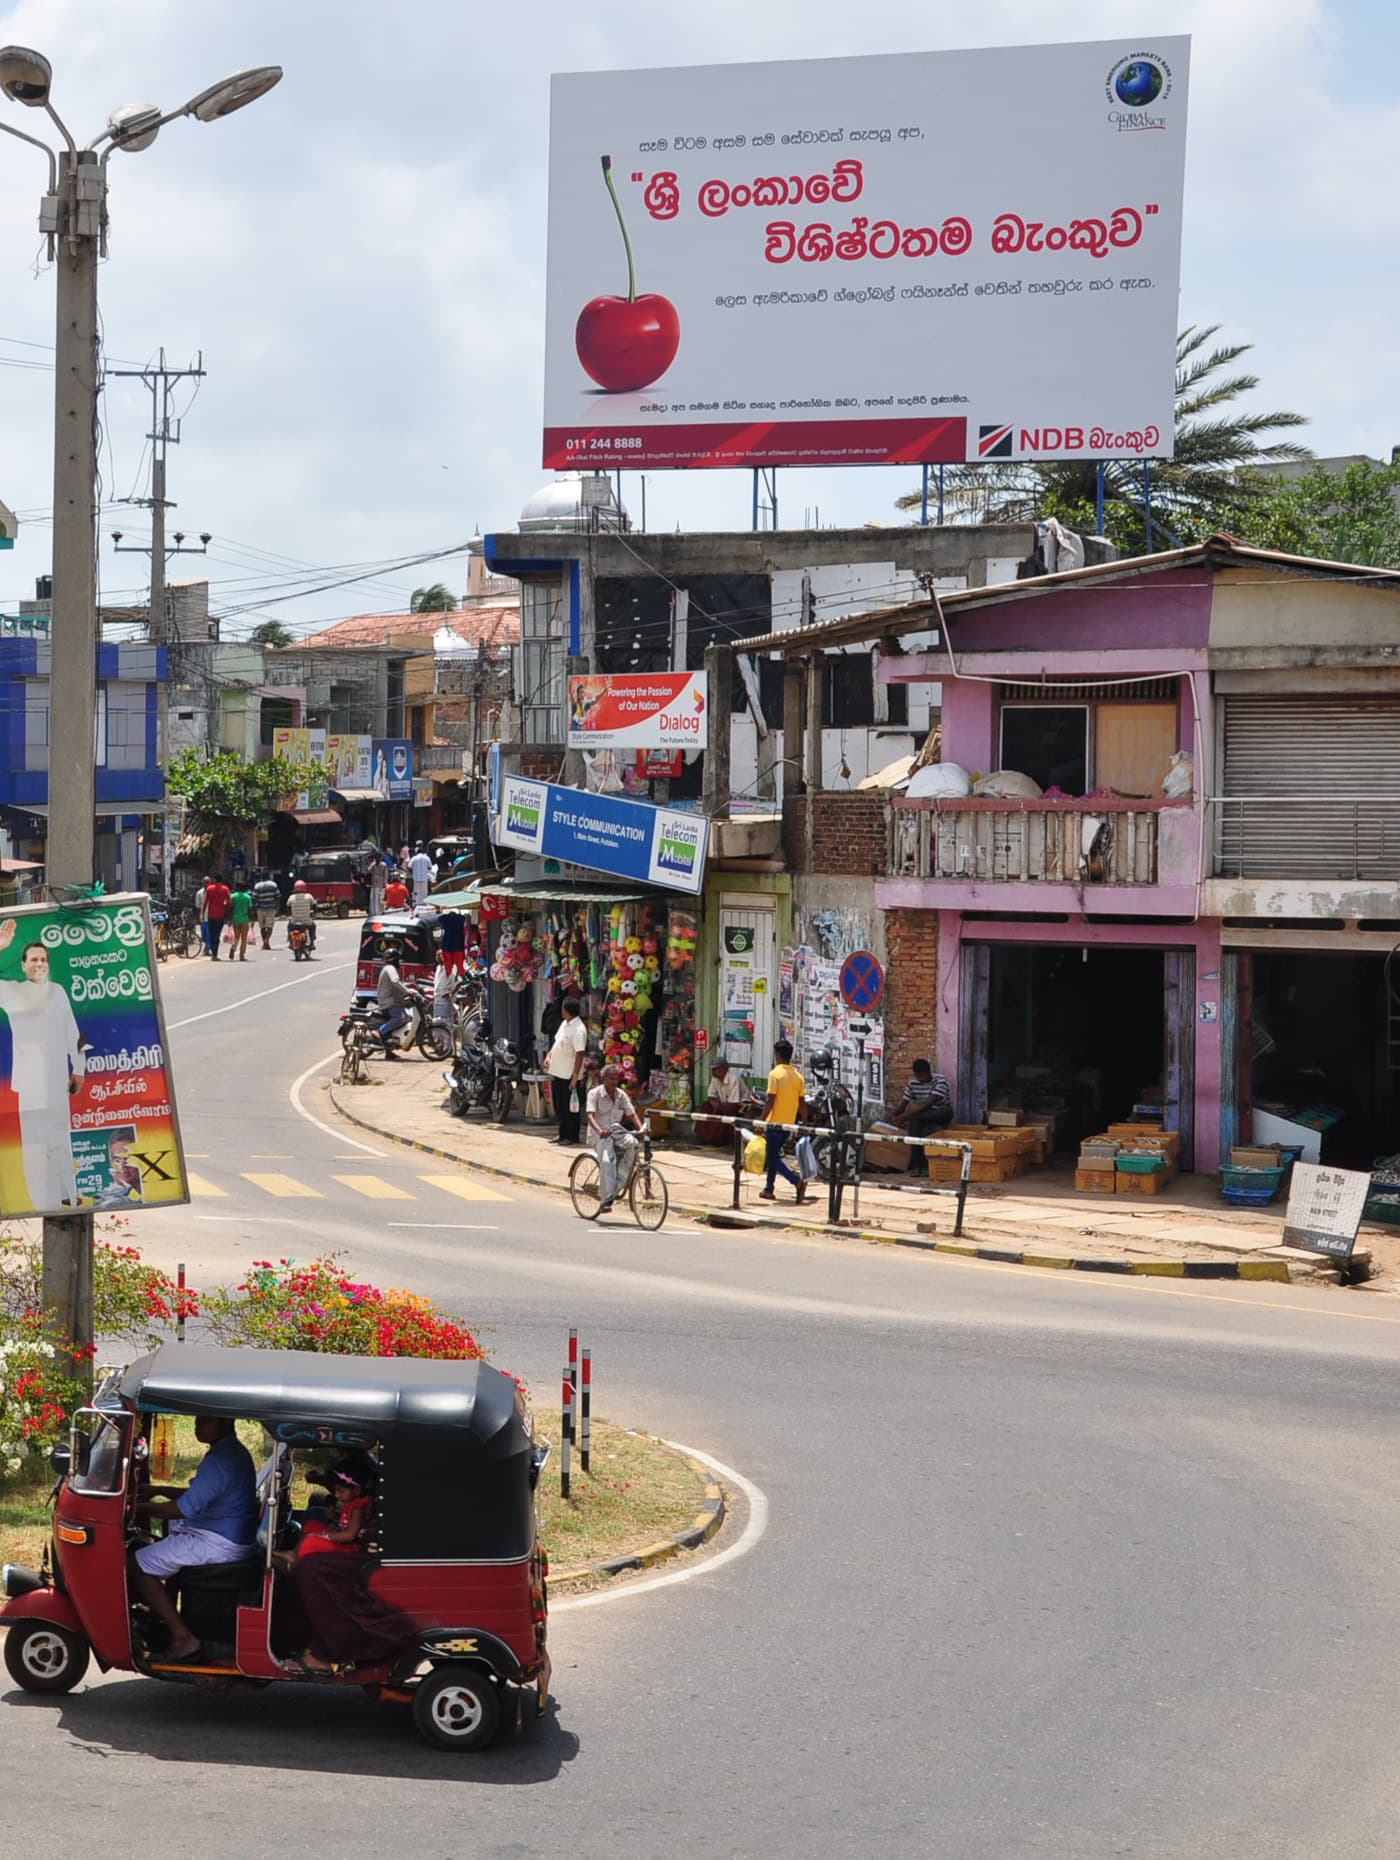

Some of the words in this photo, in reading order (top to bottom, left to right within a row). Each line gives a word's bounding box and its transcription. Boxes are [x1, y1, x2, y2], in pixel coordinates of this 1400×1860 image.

[698, 159, 864, 217] ලංකාවේ
[764, 216, 973, 264] විශිෂ්ටතම
[566, 439, 587, 450] 011
[590, 438, 611, 449] 244
[614, 437, 642, 449] 8888
[1020, 427, 1084, 451] NDB
[1088, 424, 1160, 453] බැංකුව
[608, 688, 636, 698] Powering
[637, 687, 647, 697] the
[647, 686, 673, 697] Passion
[618, 701, 626, 711] of
[626, 701, 638, 711] Our
[639, 701, 660, 711] Nation
[660, 713, 700, 733] Dialog
[510, 790, 541, 809] Telecom
[553, 811, 577, 827] STYLE
[578, 816, 645, 842] COMMUNICATION
[662, 823, 698, 844] Telecom
[71, 967, 153, 1002] එක්වෙමු
[87, 1044, 164, 1075] மைத்திரி
[90, 1078, 148, 1101] ஆட்சியில்
[1310, 1207, 1321, 1215] MAIN
